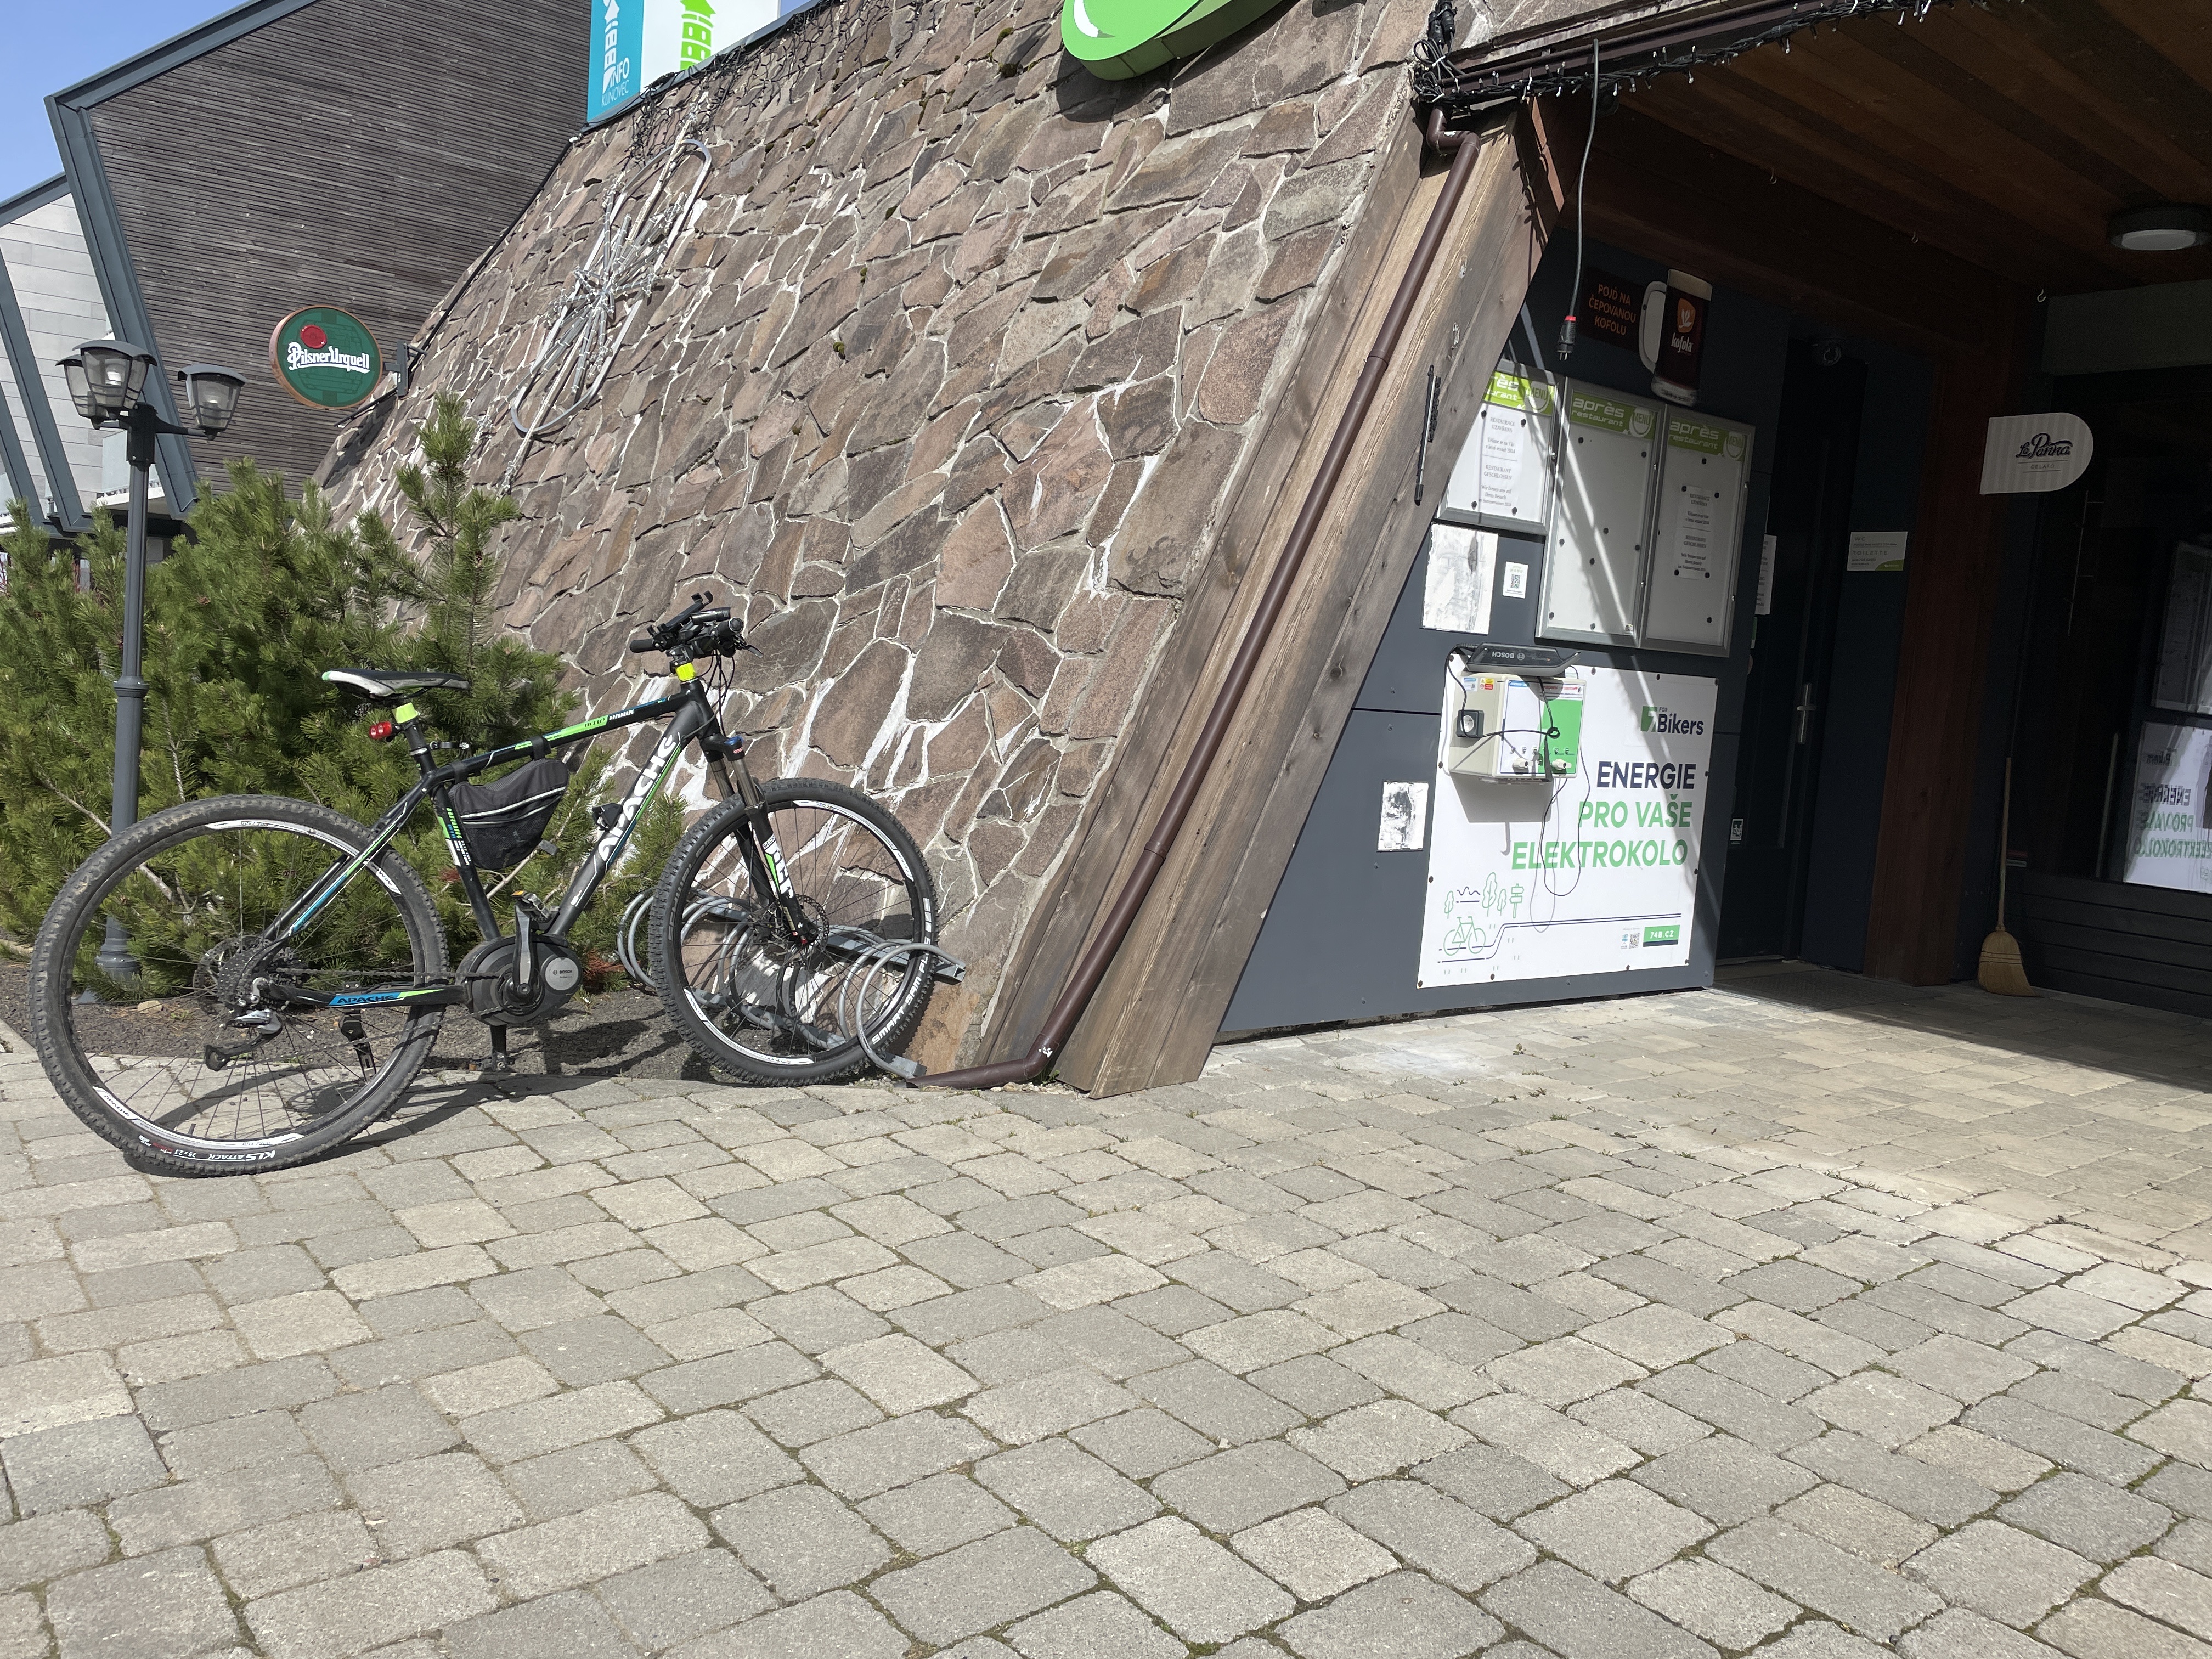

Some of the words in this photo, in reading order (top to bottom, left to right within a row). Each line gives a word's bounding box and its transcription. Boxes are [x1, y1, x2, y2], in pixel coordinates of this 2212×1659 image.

[610, 57, 629, 88] INFO
[1589, 294, 1636, 323] ČEPOVANOU
[1620, 292, 1630, 306] NA
[1594, 315, 1627, 335] KOFOLU
[1671, 332, 1692, 353] kofola
[287, 341, 331, 370] Pilsner
[329, 346, 370, 372] Urquell
[1531, 386, 1548, 400] MENU
[1572, 397, 1624, 418] après
[1571, 410, 1624, 427] restaurant
[1669, 421, 1719, 439] après
[1669, 433, 1718, 449] restaurant
[1491, 651, 1514, 659] BOSCH
[1657, 712, 1704, 735] Bikers
[1596, 761, 1697, 789] ENERGIE
[598, 734, 676, 861] APACHE
[1578, 800, 1628, 828] PRO
[1635, 793, 1693, 828] VAŠE
[1511, 839, 1688, 870] ELEKTROKOLO
[1650, 930, 1674, 939] 74B.CZ
[337, 995, 394, 1004] APACHE
[871, 1005, 905, 1045] SMART
[905, 975, 922, 1006] SAM
[919, 936, 932, 974] PLS
[246, 1150, 276, 1161] KLS
